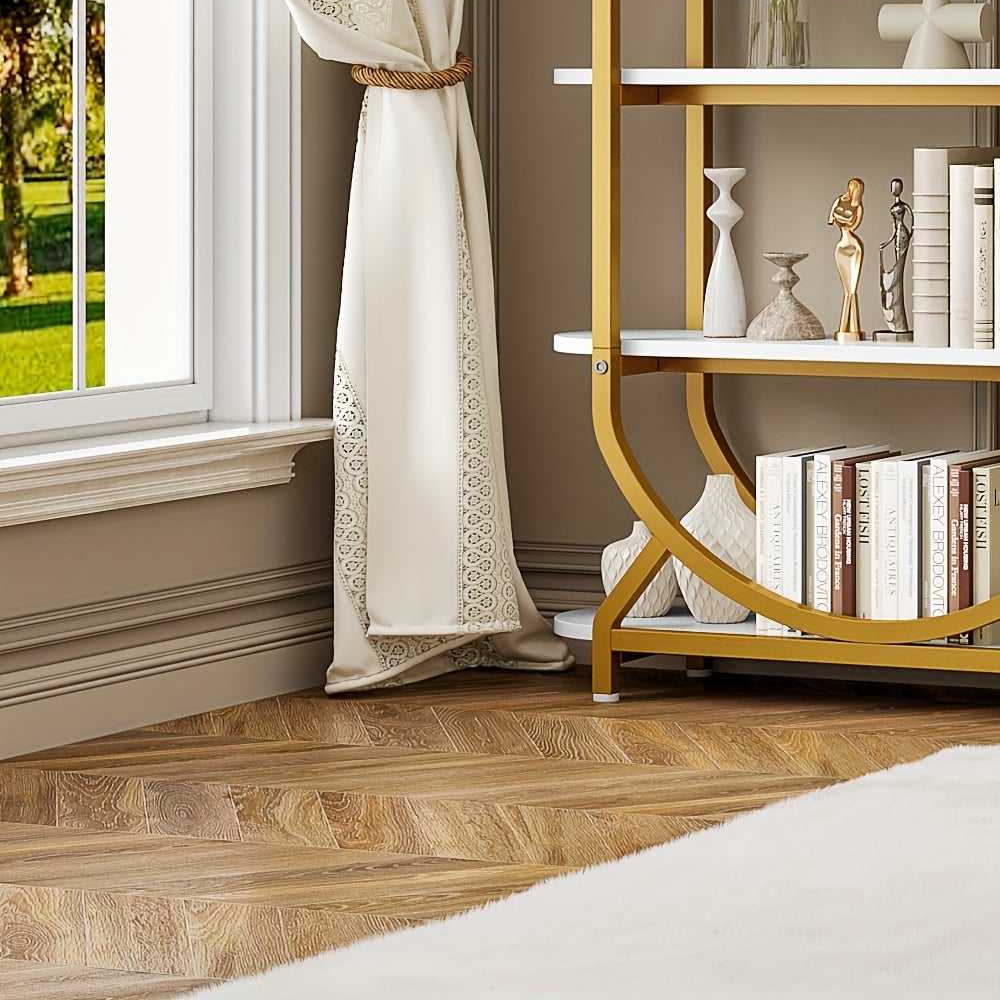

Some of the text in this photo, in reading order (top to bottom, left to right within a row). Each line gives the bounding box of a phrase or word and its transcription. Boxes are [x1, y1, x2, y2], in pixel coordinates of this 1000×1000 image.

[816, 460, 829, 522] ALEXEY
[858, 469, 870, 544] LOST FISH
[932, 464, 945, 526] ALEXEY
[975, 474, 987, 550] LOST FISH
[834, 514, 842, 591] Gardens in France
[887, 507, 896, 596] ANTIQUAIRES
[950, 519, 958, 596] Gardens in France
